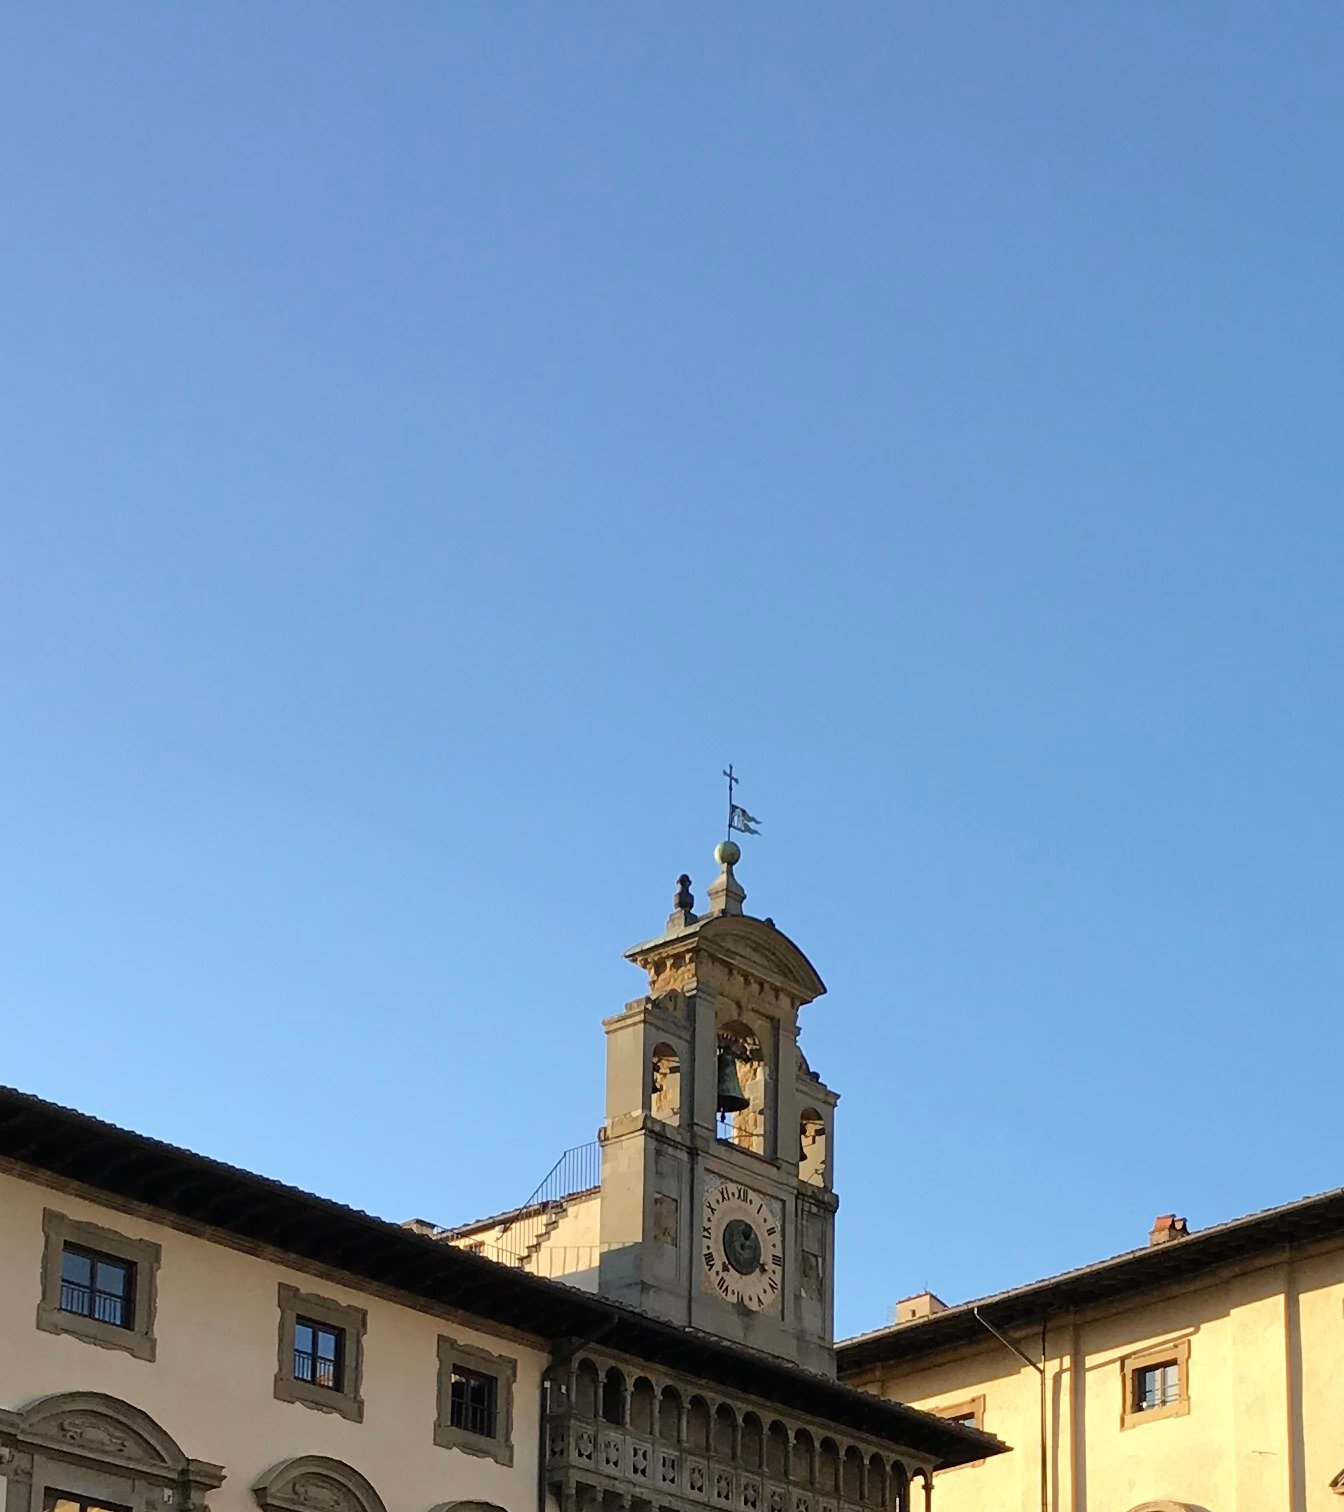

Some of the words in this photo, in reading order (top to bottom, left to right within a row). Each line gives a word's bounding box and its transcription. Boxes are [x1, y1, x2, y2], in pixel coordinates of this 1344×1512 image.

[719, 1186, 730, 1202] XI
[736, 1186, 748, 1203] XII
[706, 1201, 716, 1215] X
[757, 1203, 763, 1214] I
[702, 1226, 711, 1239] IX
[767, 1227, 776, 1236] II
[703, 1251, 715, 1272] VIII
[772, 1254, 782, 1267] III
[717, 1276, 729, 1297] VII
